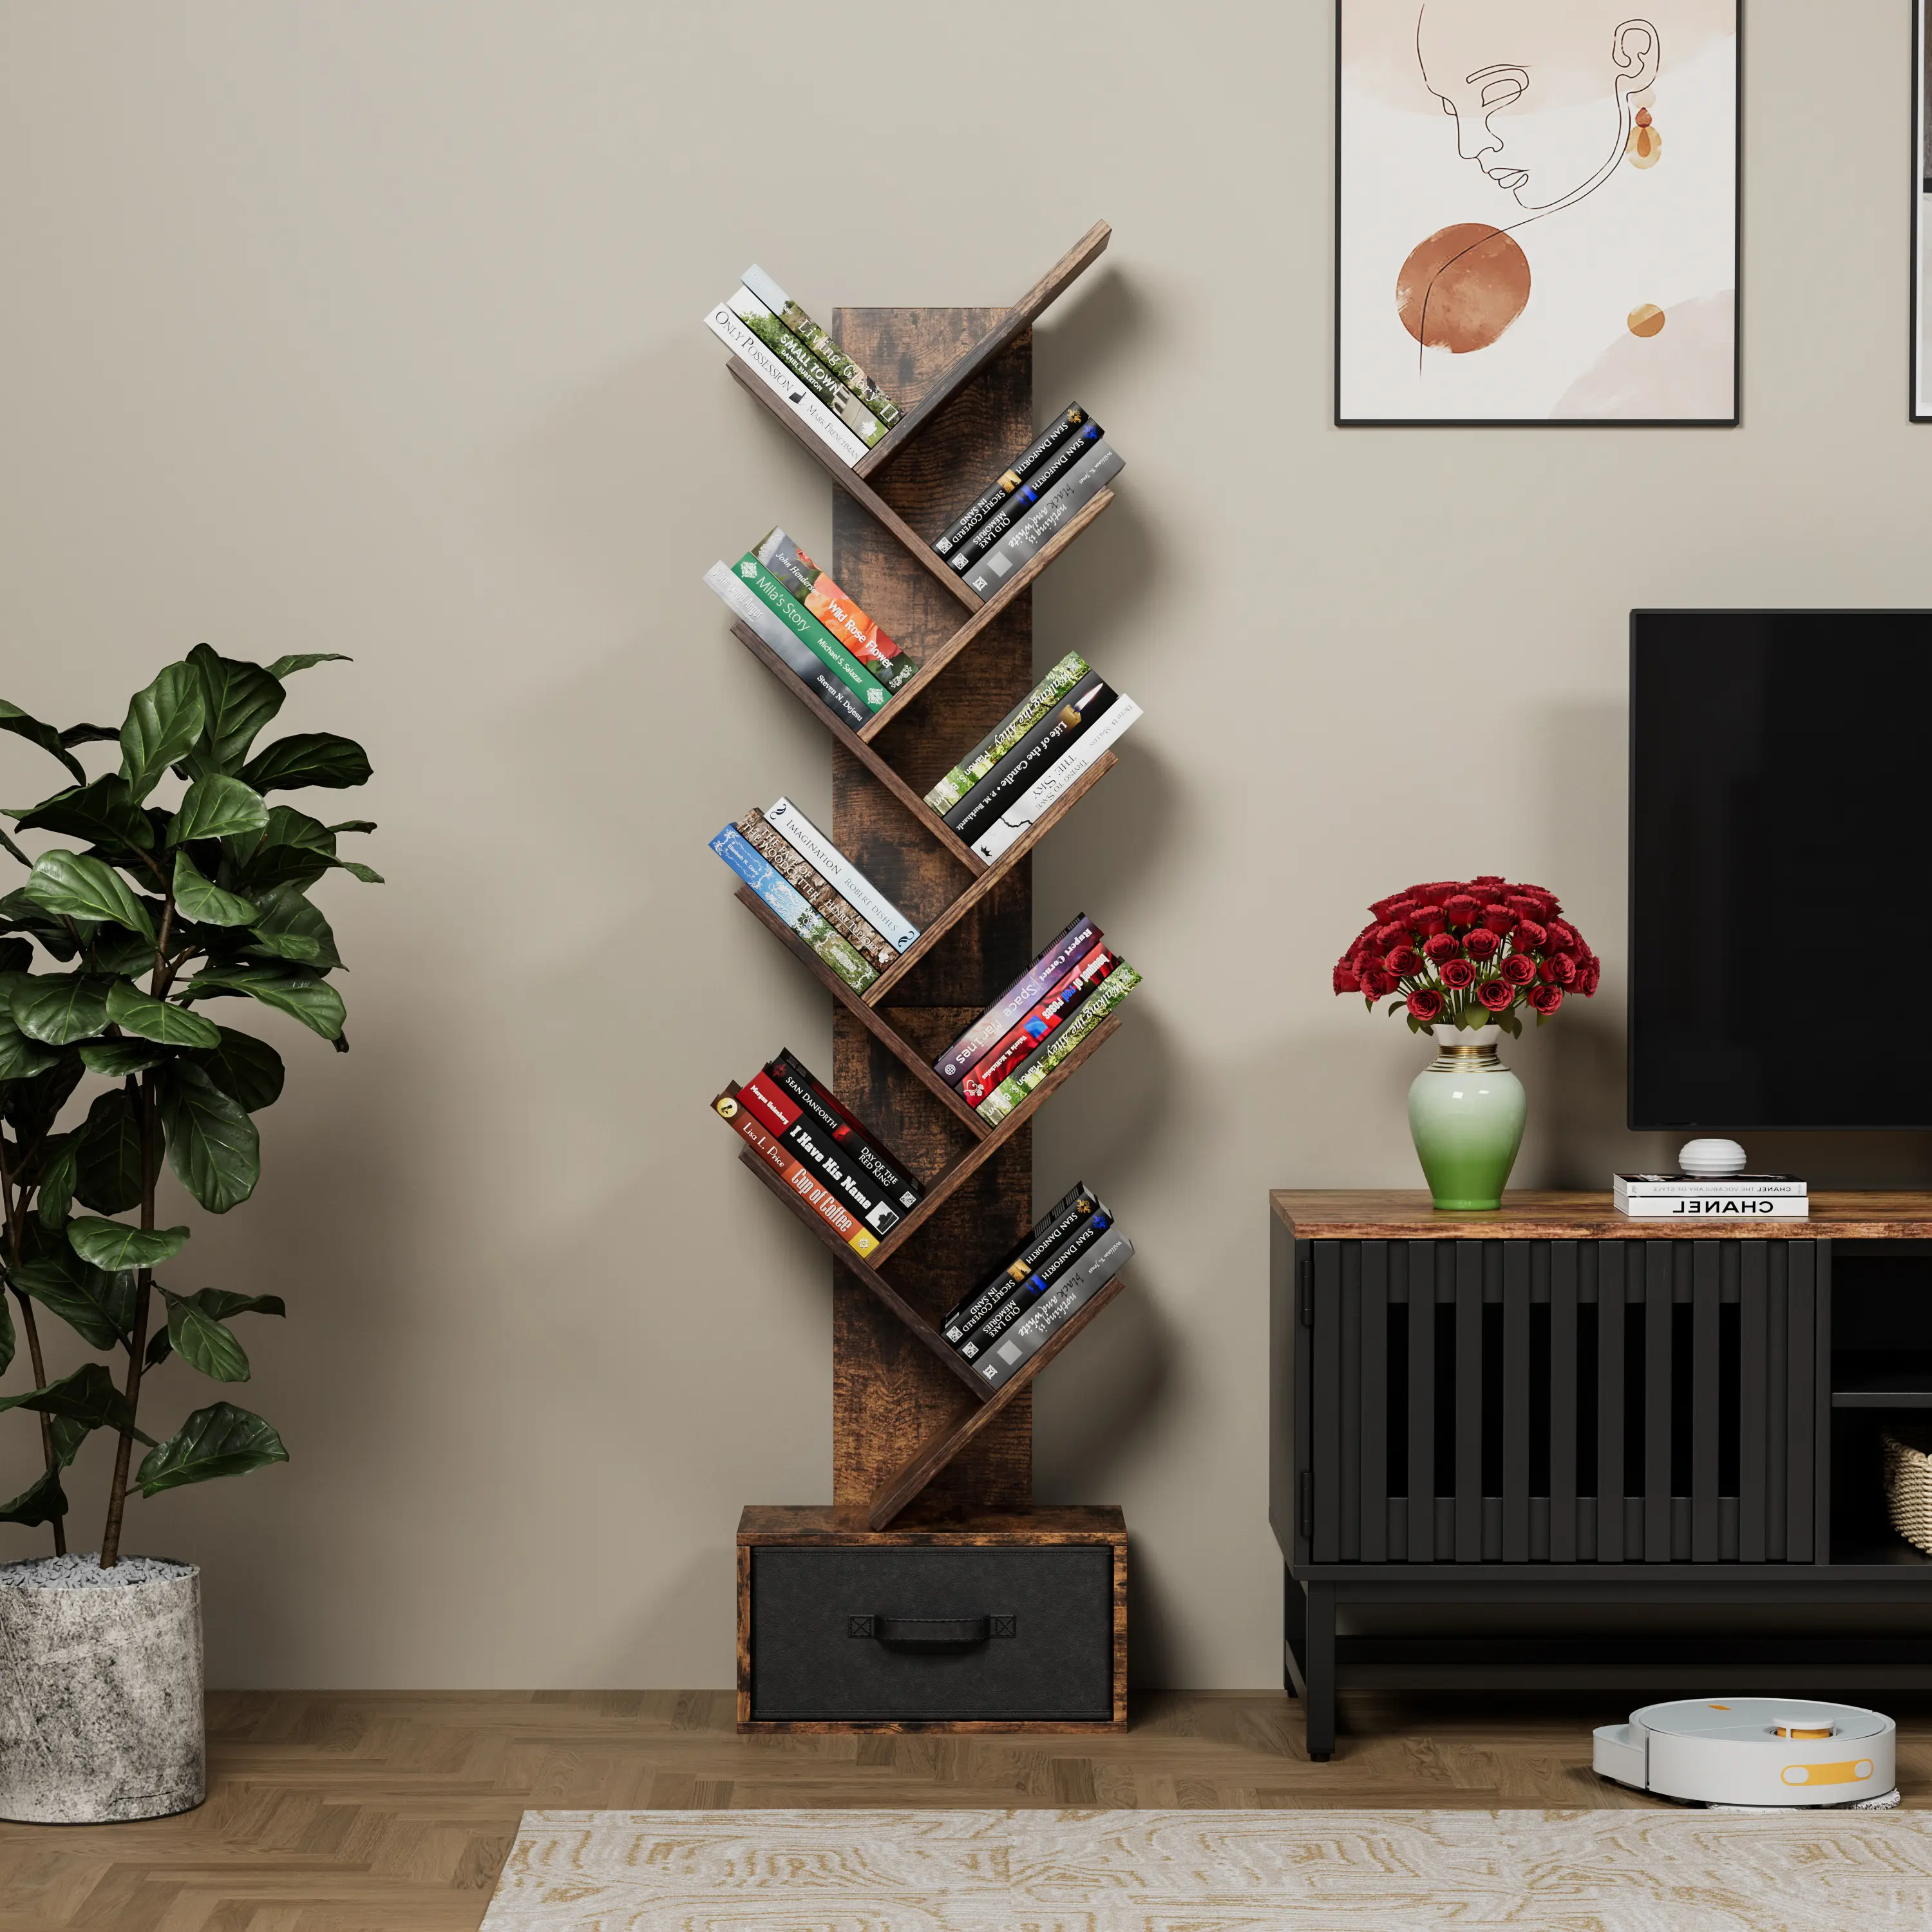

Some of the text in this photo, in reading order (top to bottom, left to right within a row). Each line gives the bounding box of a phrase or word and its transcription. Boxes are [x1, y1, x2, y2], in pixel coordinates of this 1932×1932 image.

[716, 312, 860, 459] ONLY POSSESSION MARK FRENCHMAN
[781, 334, 840, 395] SMALL TOWN
[781, 349, 823, 392] DANIEL RUBERTON
[798, 319, 878, 402] Living Glory
[1016, 422, 1068, 475] SEAN DANFORTH
[1032, 438, 1084, 491] SEAN DANFORTH
[952, 489, 1005, 543] SECRET COVERED
[960, 498, 987, 526] IN SAND
[972, 511, 1007, 545] MEMORIES
[978, 518, 1010, 549] OLD LAKE
[1009, 484, 1074, 547] black and white
[1029, 504, 1066, 544] nothing is
[728, 582, 748, 605] Cloud
[744, 598, 764, 619] Anger
[775, 553, 822, 598] John Henderson
[756, 576, 784, 607] Mila's
[783, 603, 810, 631] Story
[817, 638, 841, 661] Michael
[842, 663, 863, 684] Salazar
[828, 600, 894, 668] Wild Rose Flower
[817, 675, 863, 721] Steven N. Dejesu
[994, 670, 1076, 746] Walking the Alley
[1001, 721, 1068, 786] Life of the Candle
[1089, 726, 1112, 747] MALLON
[934, 750, 992, 806] Marion S. Brwn
[1033, 755, 1077, 799] THE SKY
[1036, 760, 1088, 810] TRYING TO SAVE
[956, 802, 984, 831] Burkhardt
[728, 844, 744, 862] Elizabeth
[748, 864, 759, 876] Davis
[743, 822, 762, 842] THE
[761, 841, 819, 901] WOODCUTTER
[761, 827, 813, 878] THE FATE OF
[786, 820, 842, 875] IMAGINATION
[845, 878, 873, 907] ROBERT
[871, 905, 898, 931] DISHES
[826, 899, 878, 952] HENRY TUPPORT
[956, 929, 1093, 1064] Rupert Cornet Space Marines
[1041, 953, 1110, 1020] bouquet of red roses
[1010, 1036, 1027, 1051] Valerie
[1047, 980, 1127, 1057] Walking the Alley
[981, 1054, 1007, 1079] McNicholas
[987, 1061, 1043, 1117] Marion S. Bwn
[750, 1084, 768, 1104] Morgan
[786, 1077, 837, 1128] SEAN DANFORTH
[743, 1122, 784, 1167] Lisa L. Price
[790, 1124, 871, 1209] I Have His Name
[859, 1154, 890, 1186] RED KING
[860, 1146, 898, 1185] DAY OF THE
[791, 1168, 853, 1232] Cup of Coffee
[1025, 1212, 1078, 1264] SEAN DANFORTH
[1042, 1228, 1094, 1280] SEAN DANFORTH
[962, 1280, 1015, 1332] SECRET COVERED
[970, 1287, 998, 1314] IN SAND
[983, 1300, 1016, 1334] MEMORIES
[989, 1307, 1020, 1337] OLD LAKE
[1018, 1273, 1084, 1337] black and white
[1038, 1293, 1077, 1333] nothing is
